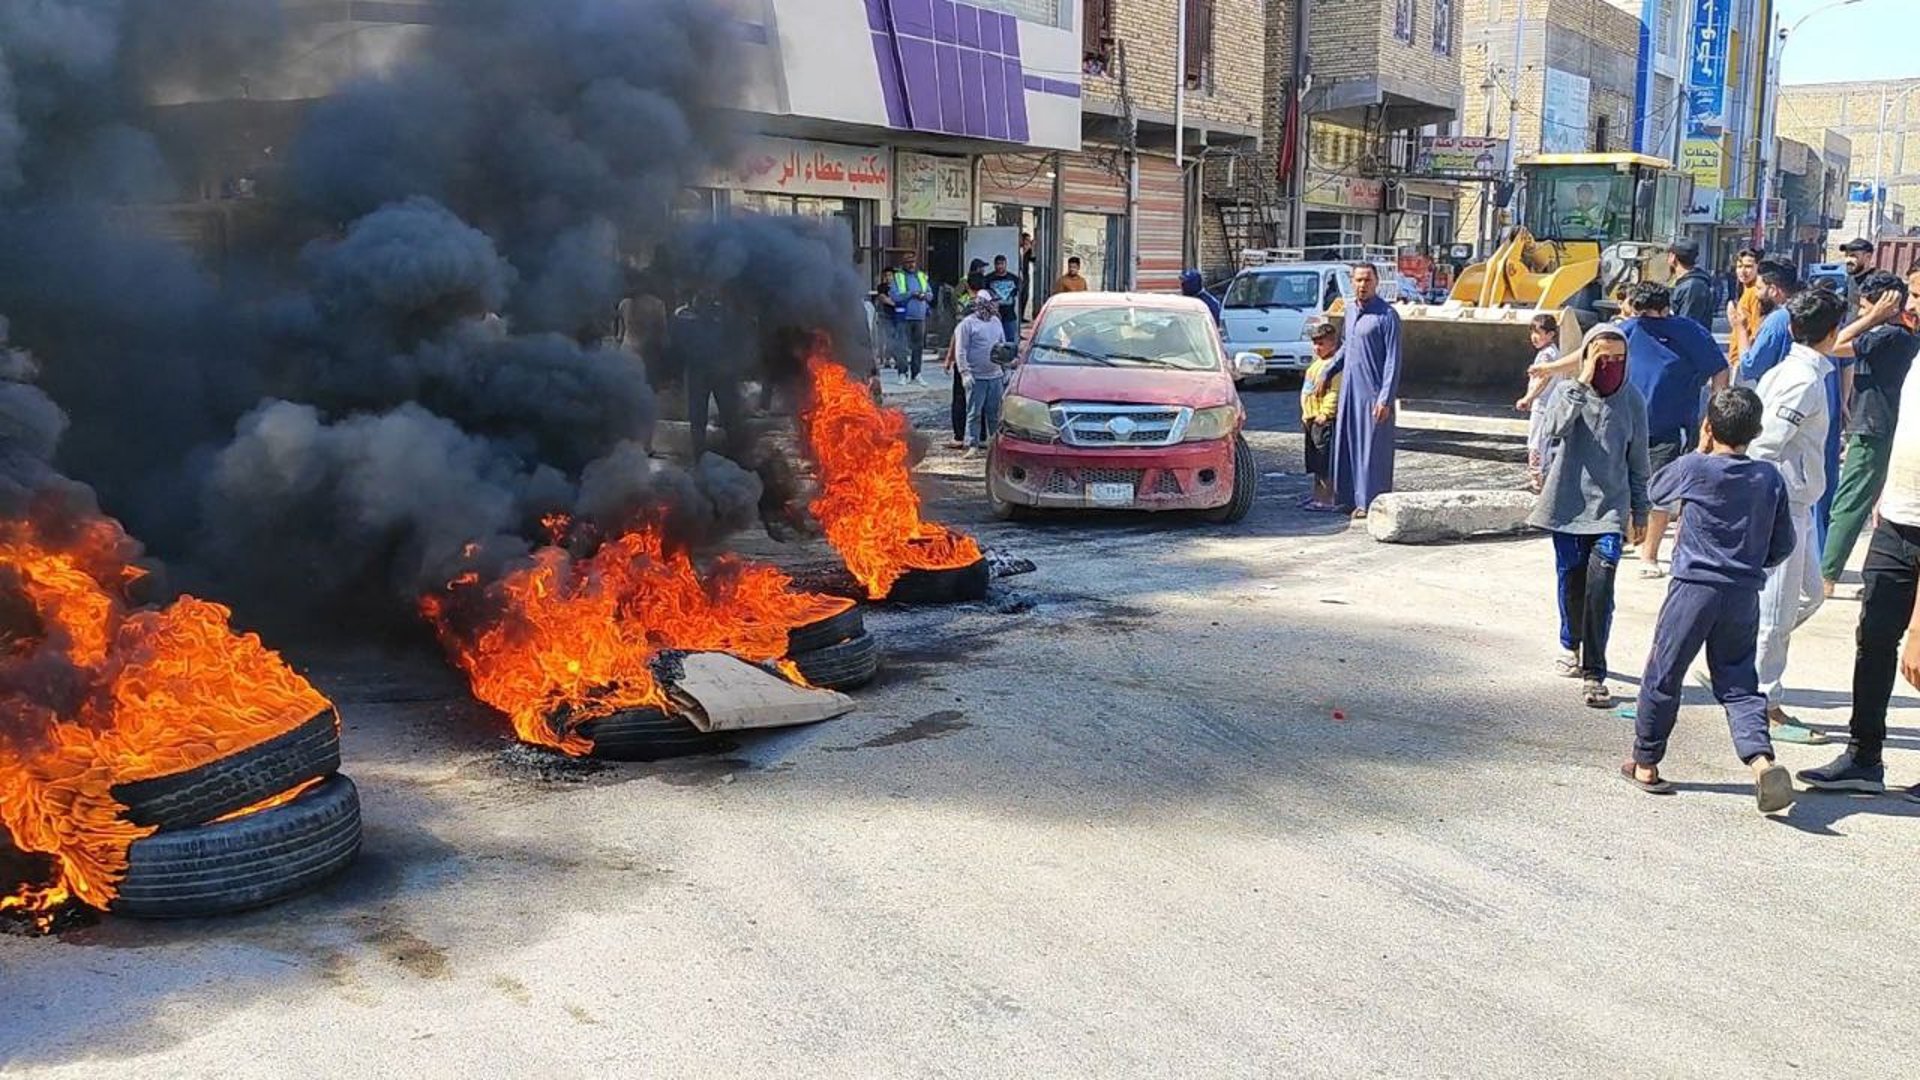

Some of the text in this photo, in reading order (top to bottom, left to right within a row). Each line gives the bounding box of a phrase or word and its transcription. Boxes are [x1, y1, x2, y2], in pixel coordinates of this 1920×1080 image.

[805, 150, 844, 183] عطاء
[1684, 147, 1719, 157] محلات
[848, 154, 886, 192] مكتب
